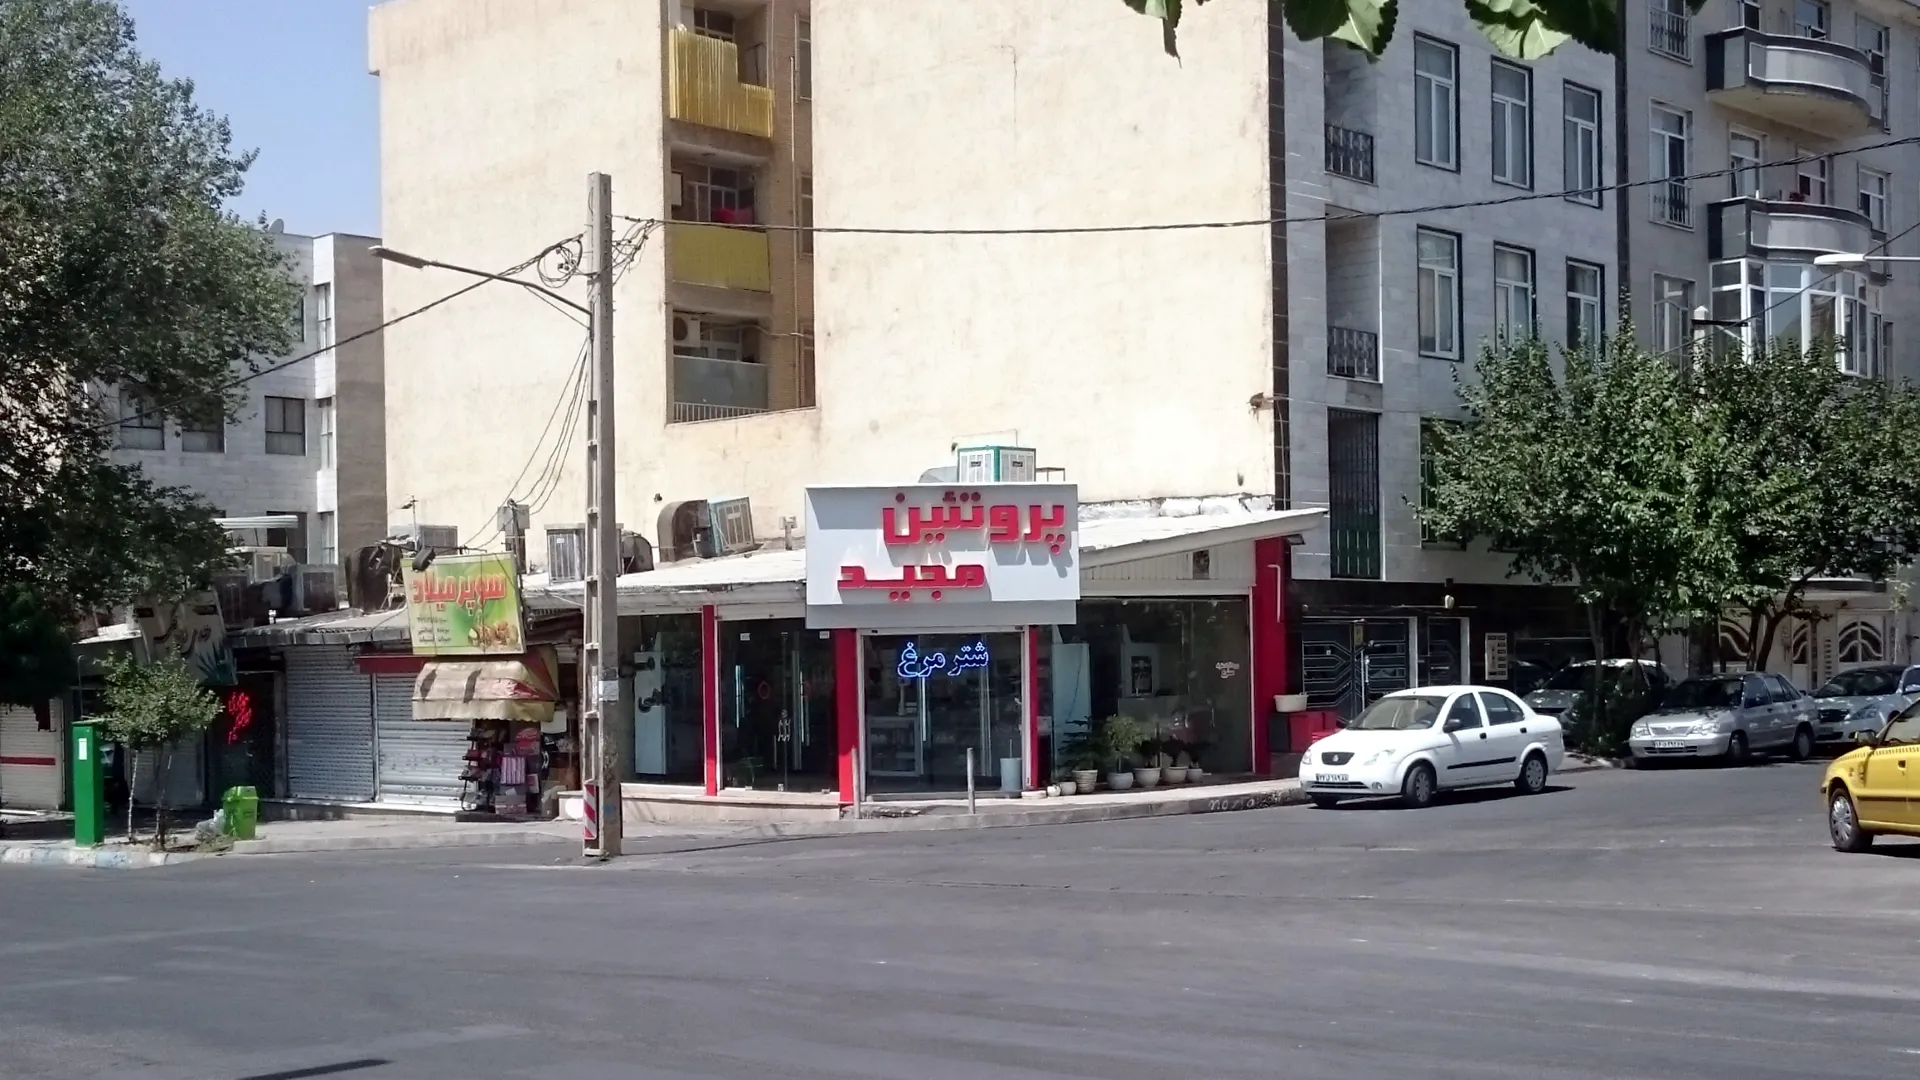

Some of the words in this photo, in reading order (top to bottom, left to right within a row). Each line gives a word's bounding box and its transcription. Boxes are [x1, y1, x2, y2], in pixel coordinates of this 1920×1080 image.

[882, 490, 1067, 555] پروتئین
[411, 571, 457, 612] میلاد
[456, 573, 507, 616] سوپر
[837, 563, 986, 601] مجید
[897, 641, 946, 679] مرغ
[947, 641, 990, 677] شتر
